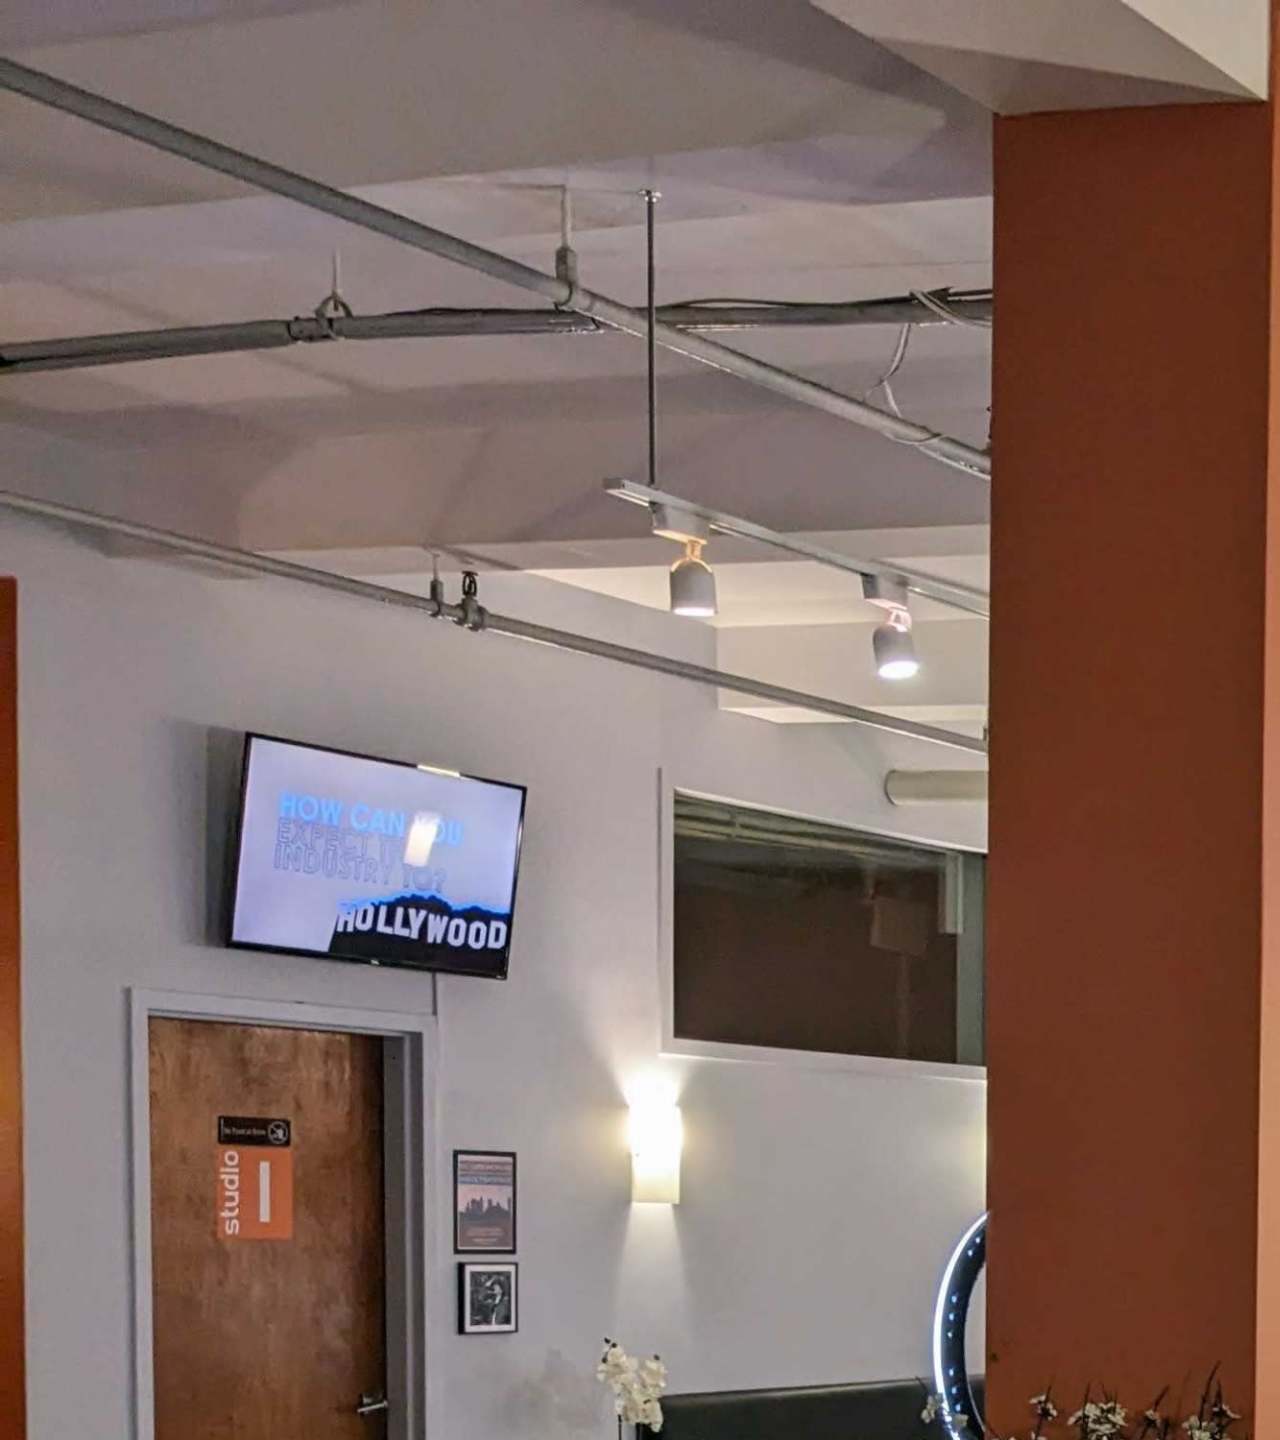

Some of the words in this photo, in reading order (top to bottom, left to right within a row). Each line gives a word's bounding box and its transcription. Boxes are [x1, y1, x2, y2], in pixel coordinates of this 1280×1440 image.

[279, 793, 342, 826] HOW
[351, 802, 405, 838] CAN
[334, 903, 508, 950] HOLLYWOOD
[220, 1151, 240, 1236] studio
